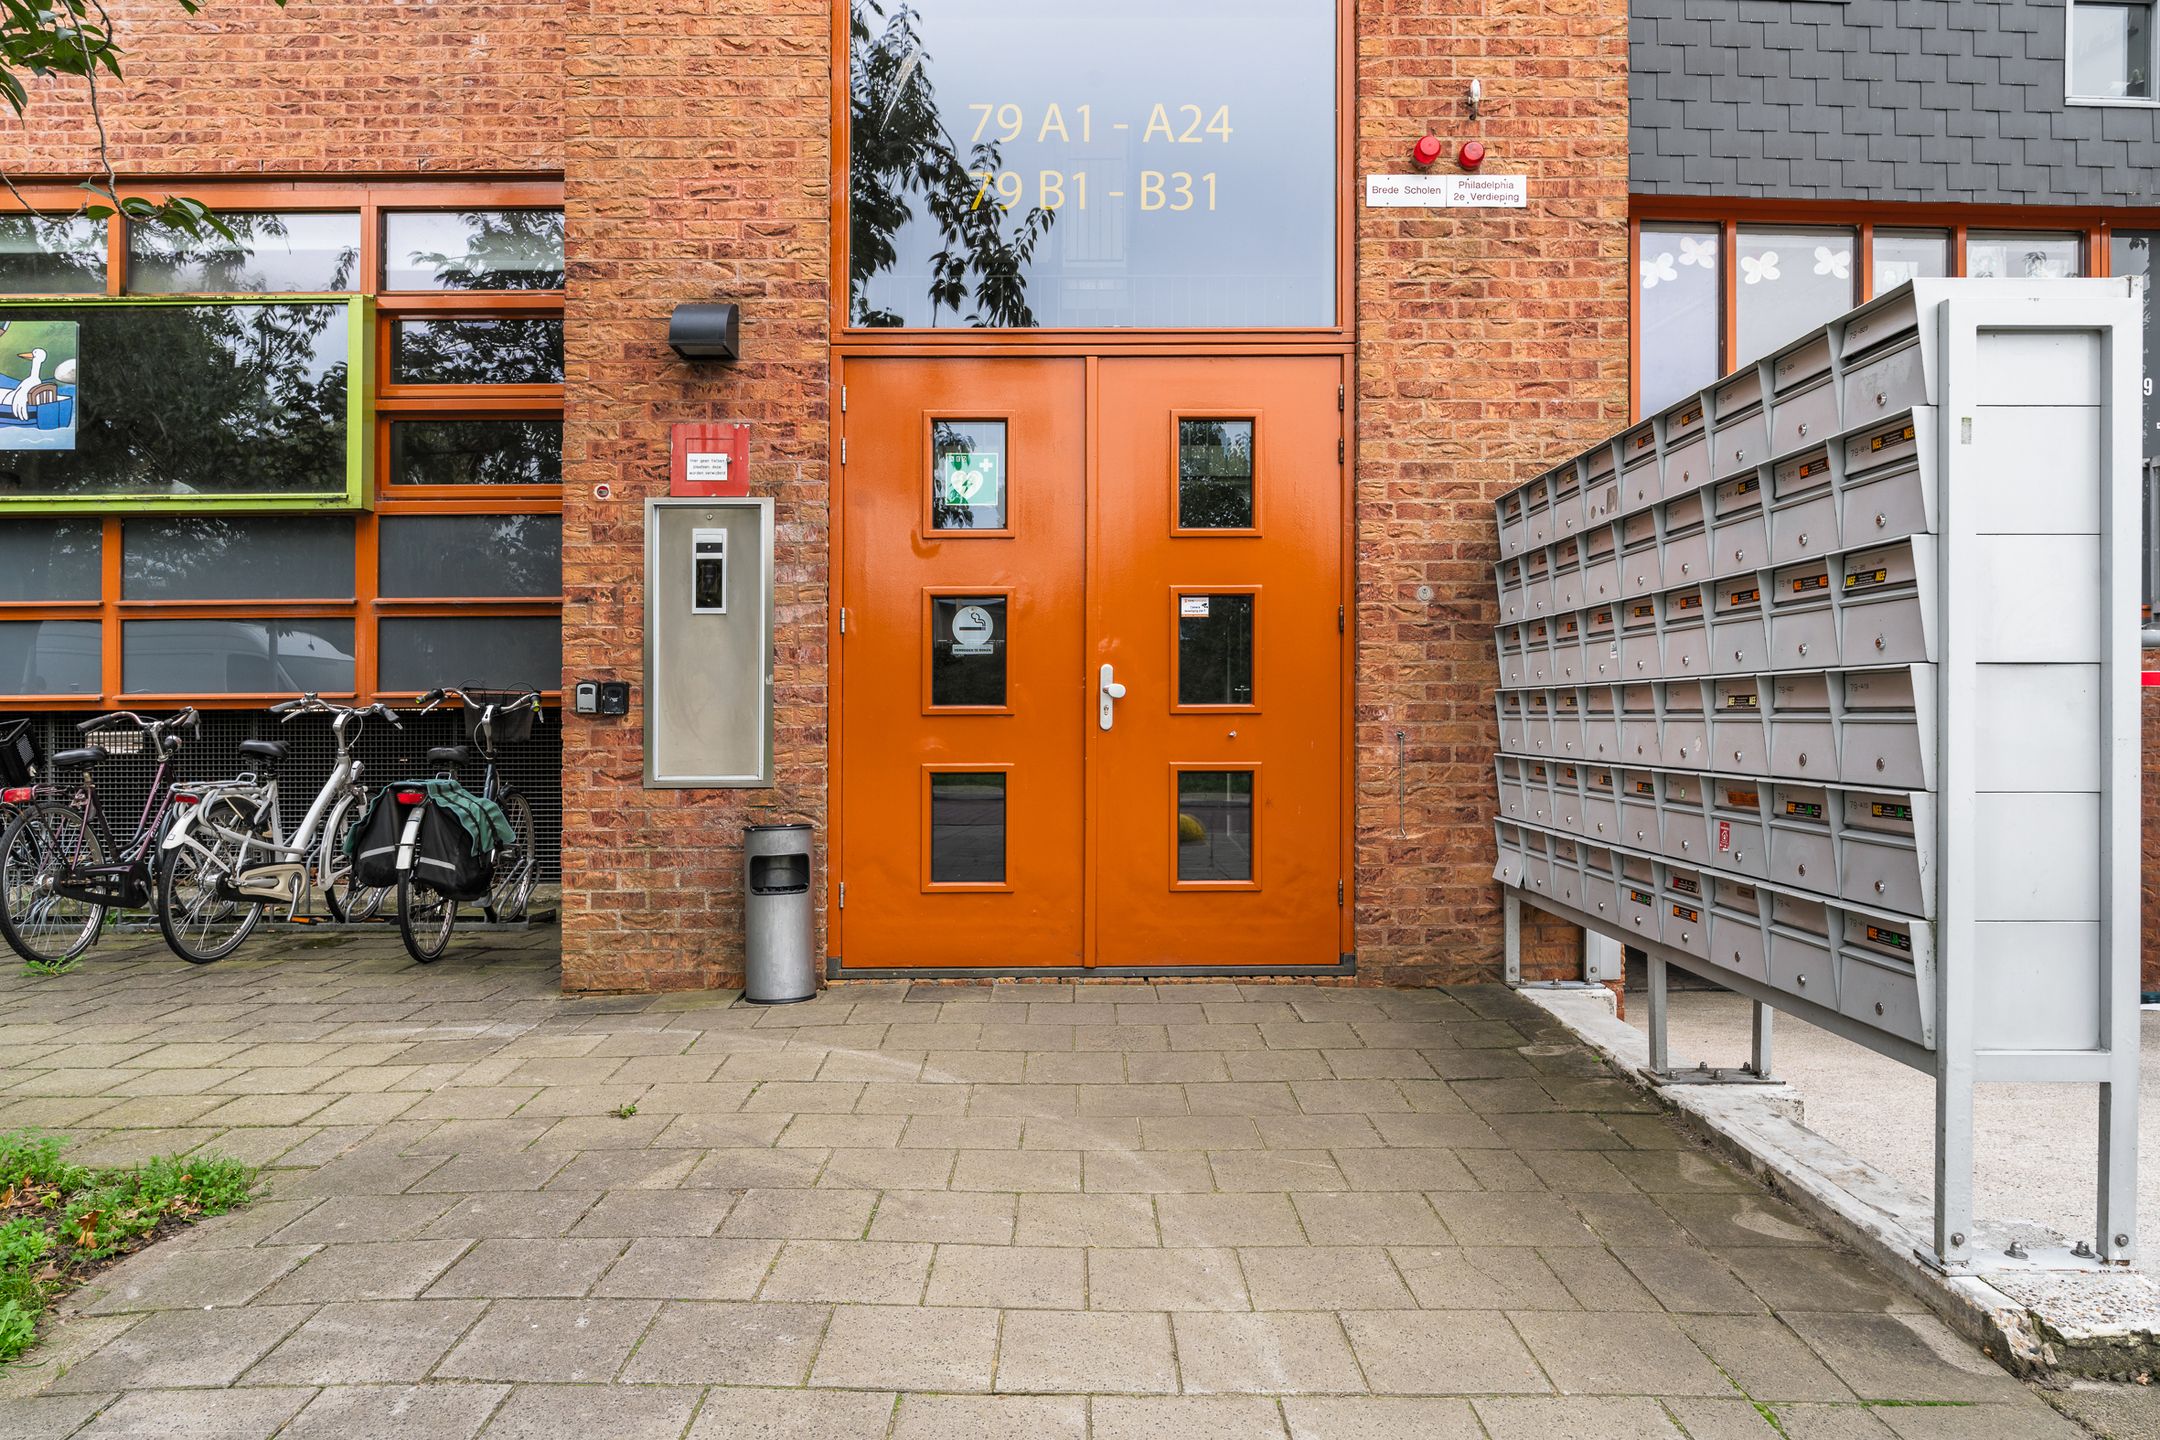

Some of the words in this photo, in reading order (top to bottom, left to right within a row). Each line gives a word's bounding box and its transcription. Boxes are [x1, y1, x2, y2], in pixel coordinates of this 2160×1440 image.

[968, 103, 1023, 143] 79
[1037, 103, 1090, 143] A1
[1142, 103, 1233, 143] A24
[968, 171, 1023, 211] 79
[1039, 170, 1086, 210] B1
[1140, 170, 1216, 211] B31
[1372, 185, 1399, 194] Brede
[1404, 185, 1441, 194] Scholen
[1458, 180, 1514, 190] Philadelphia
[1470, 192, 1520, 203] Verdieping
